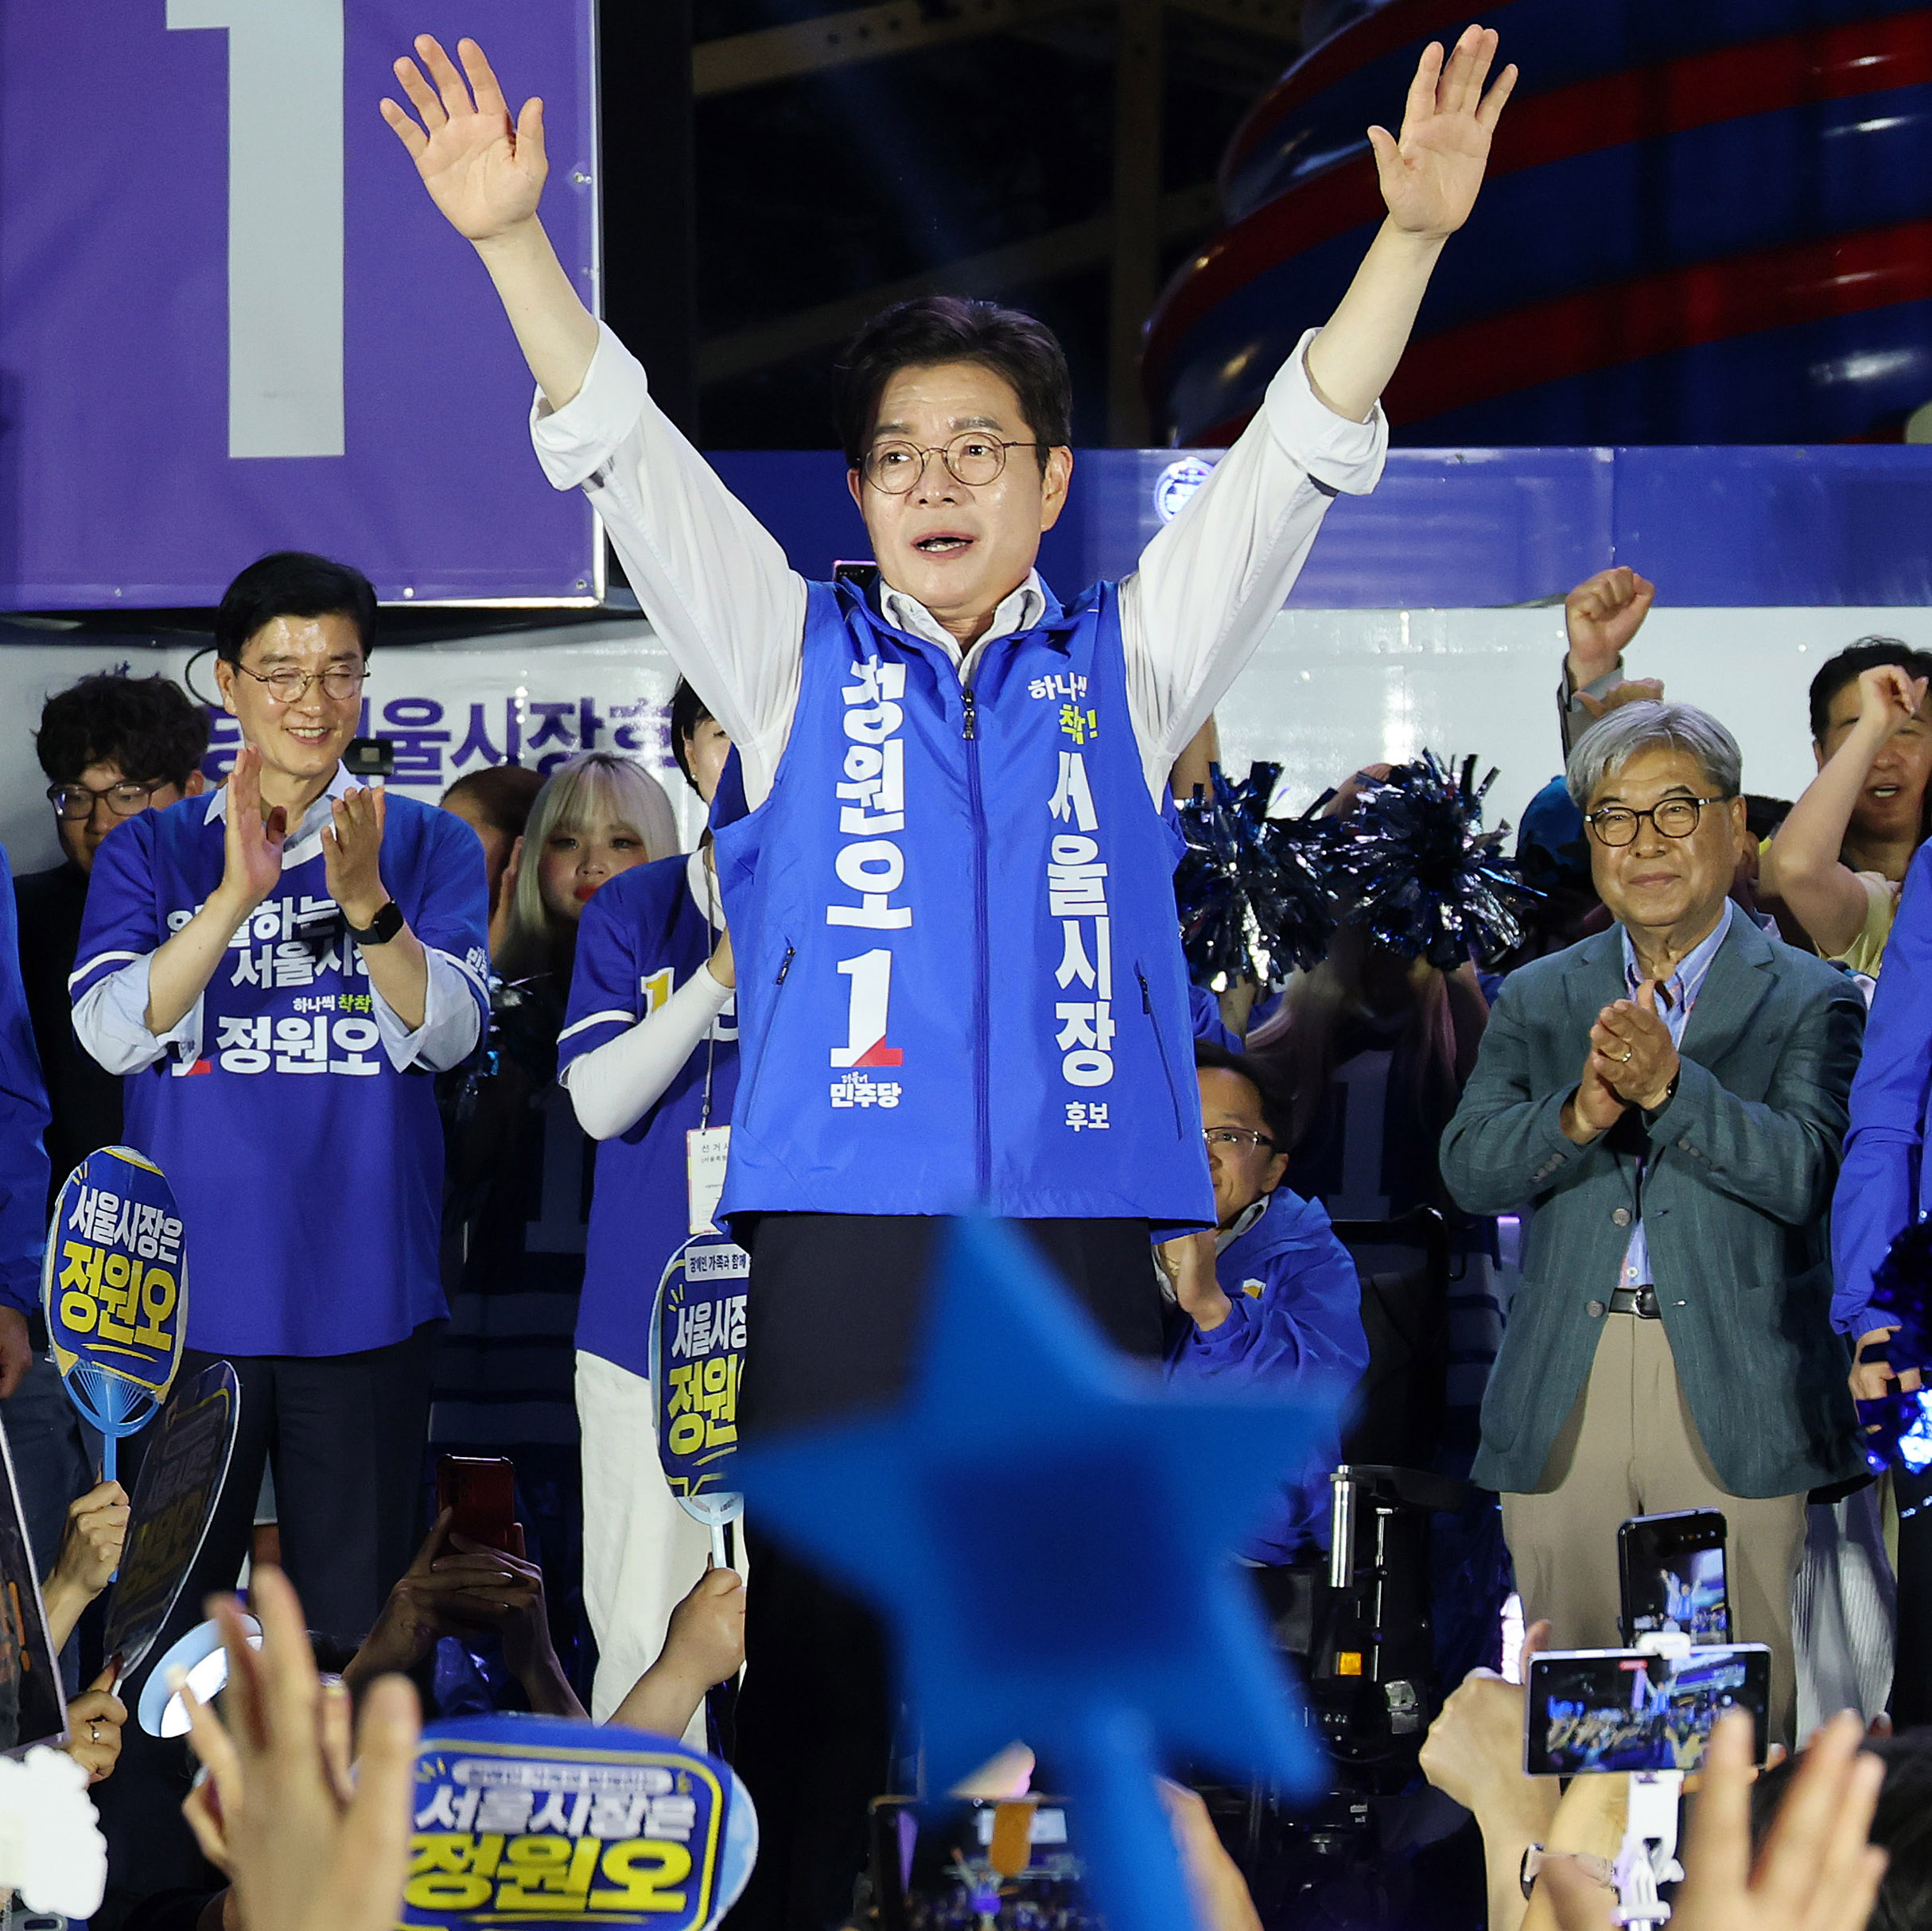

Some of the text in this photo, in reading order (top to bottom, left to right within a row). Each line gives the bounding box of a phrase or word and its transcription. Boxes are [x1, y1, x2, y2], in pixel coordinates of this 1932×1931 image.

[165, 0, 344, 458] 1
[356, 697, 681, 786] 울시장
[826, 654, 912, 930] 정원오
[230, 933, 369, 989] 서울시
[1047, 751, 1116, 1087] 서울시장
[216, 1015, 381, 1077] 정원오
[293, 993, 375, 1015] 하나씩 착착
[830, 948, 904, 1068] 1
[830, 1082, 904, 1109] 민주당
[1065, 1101, 1110, 1132] 후보
[68, 1186, 184, 1265] 서울시장은
[59, 1241, 177, 1353] 정원오
[667, 1354, 738, 1455] 정원
[402, 1832, 693, 1914] 정원오
